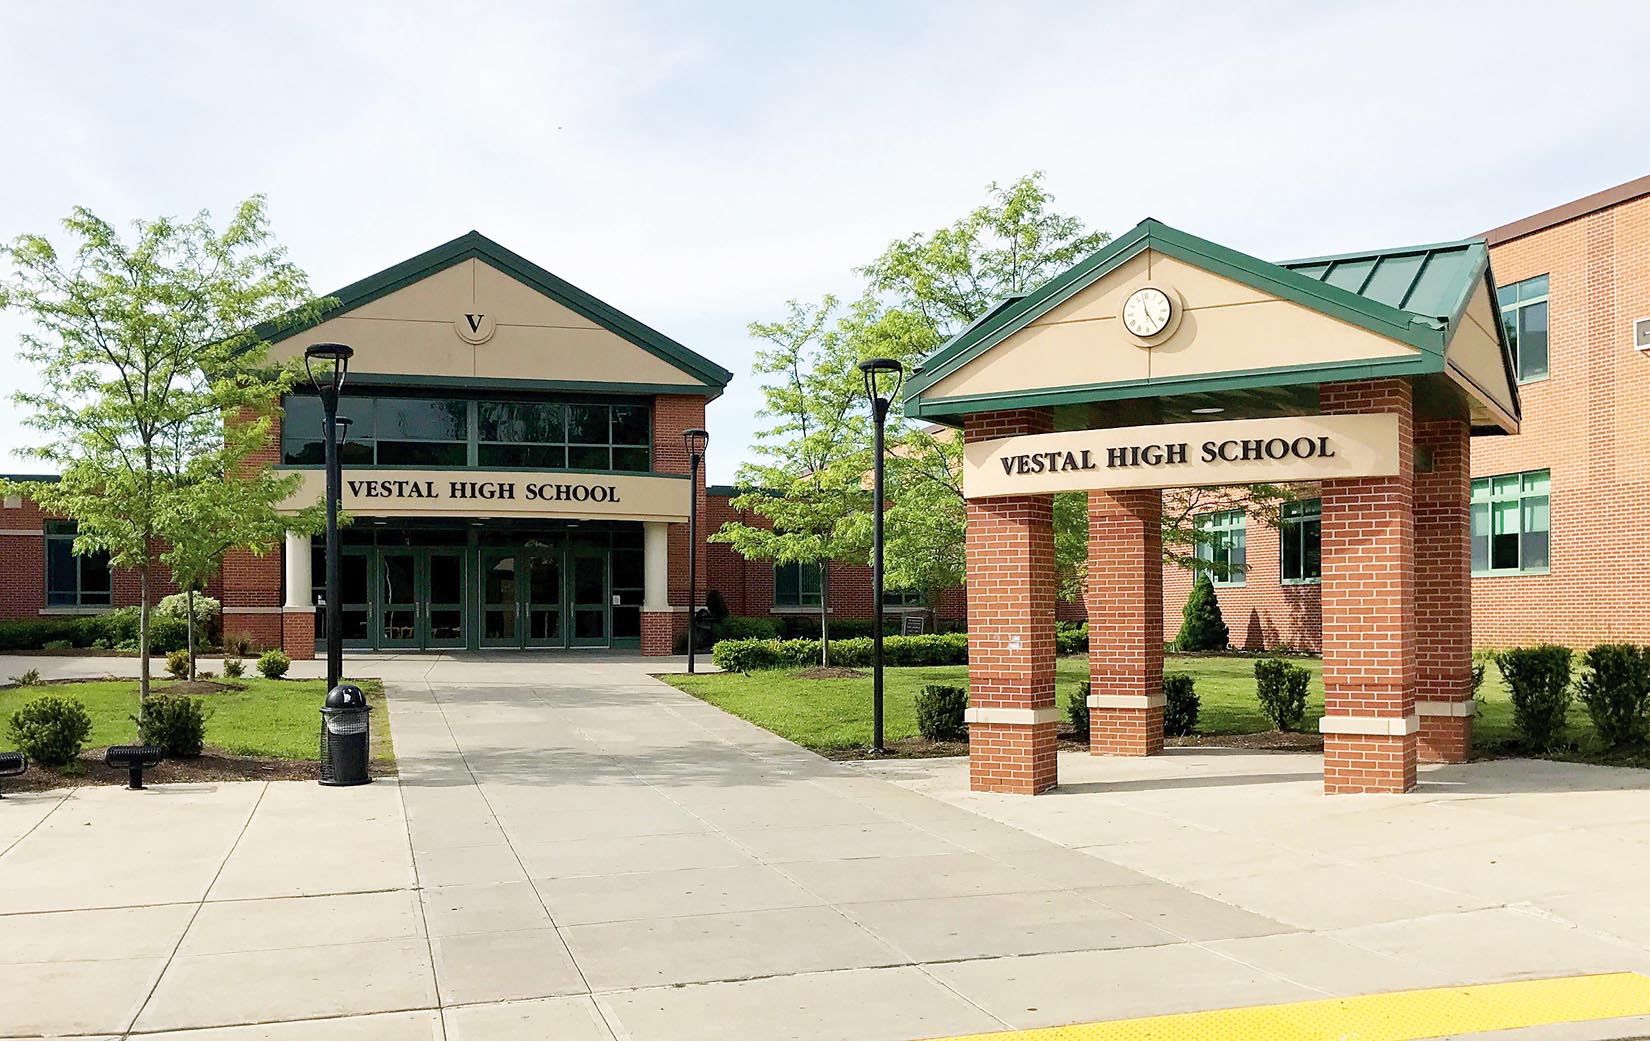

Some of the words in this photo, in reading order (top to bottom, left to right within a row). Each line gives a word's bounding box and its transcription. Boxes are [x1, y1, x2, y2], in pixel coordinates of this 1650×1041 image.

[464, 313, 485, 334] V
[999, 449, 1096, 476] VESTAL
[1106, 442, 1188, 468] HIGH
[1201, 436, 1336, 463] SCHOOL
[346, 480, 440, 499] VESTAL
[448, 481, 516, 500] HIGH
[525, 483, 621, 503] SCHOOL
